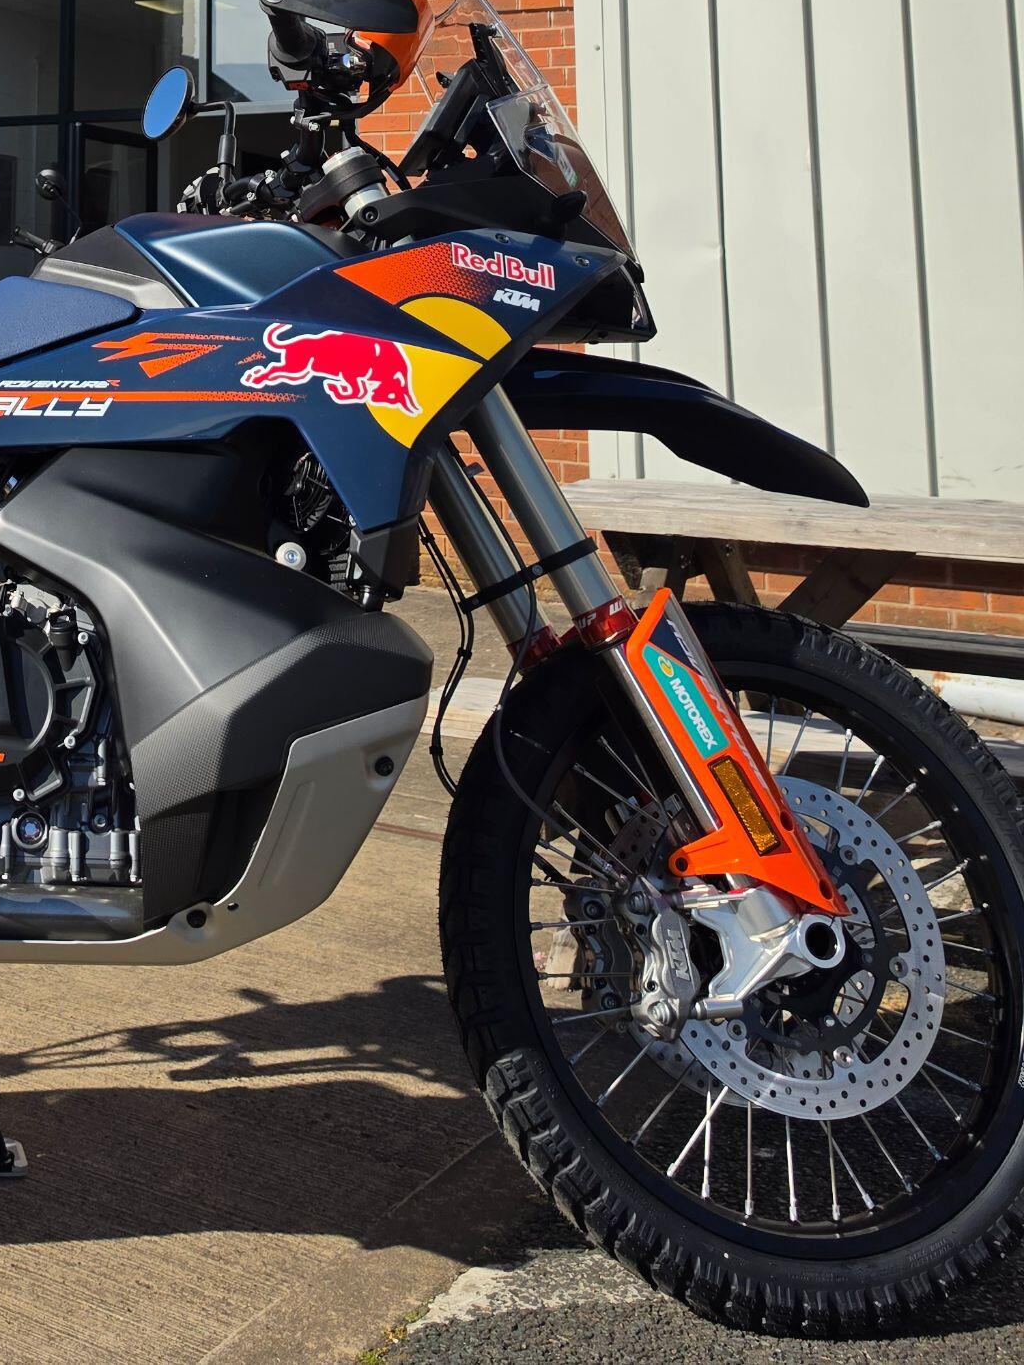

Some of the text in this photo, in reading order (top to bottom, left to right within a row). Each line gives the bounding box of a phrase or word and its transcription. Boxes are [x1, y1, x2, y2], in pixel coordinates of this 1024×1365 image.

[451, 241, 556, 291] Red Bull
[493, 288, 541, 312] KTM
[669, 678, 718, 751] MOTOREX
